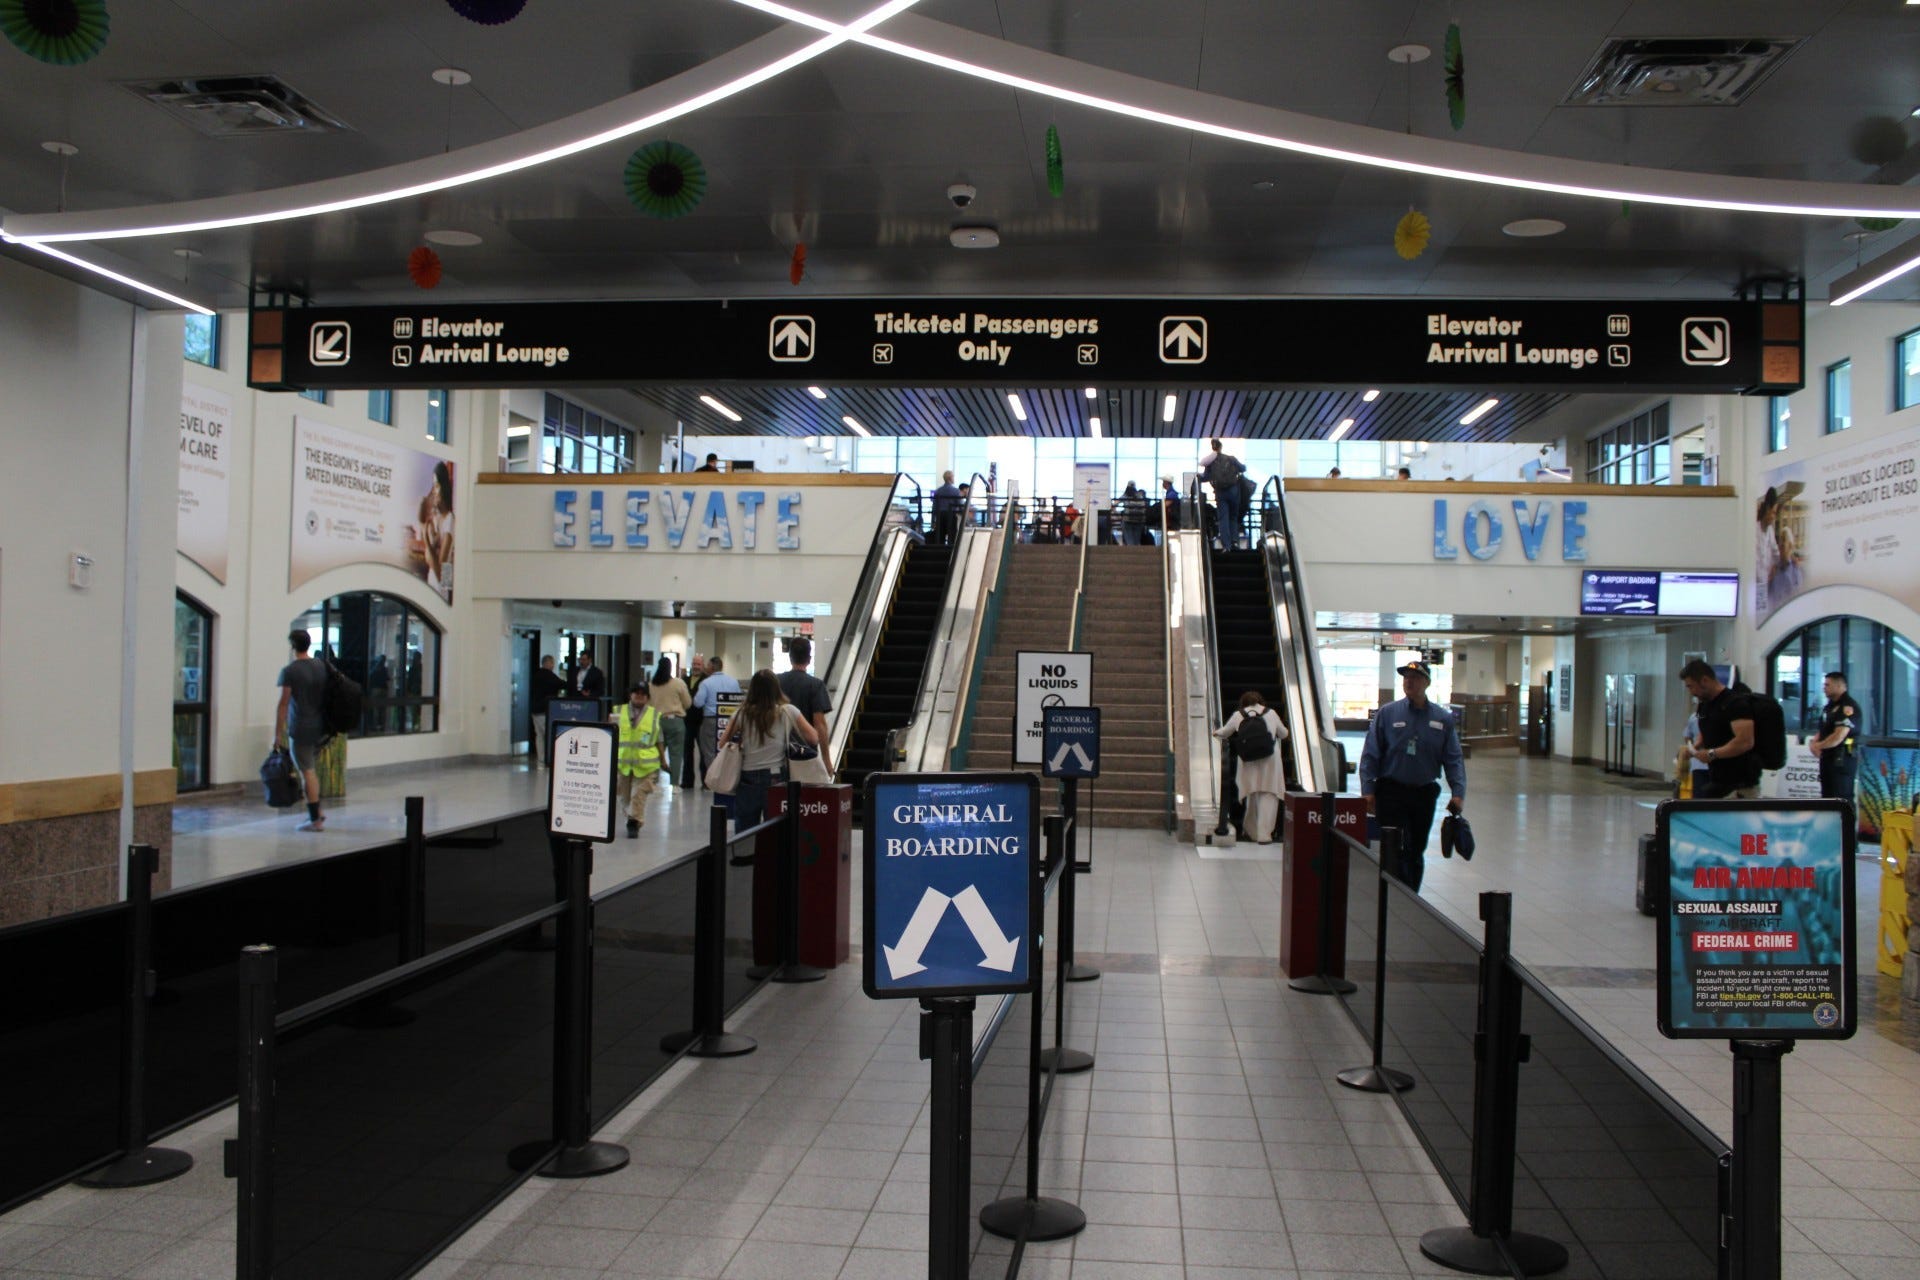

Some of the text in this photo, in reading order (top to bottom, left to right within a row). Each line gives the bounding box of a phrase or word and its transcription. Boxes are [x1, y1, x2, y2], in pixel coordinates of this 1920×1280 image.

[421, 317, 504, 338] Elevator
[874, 313, 1099, 339] Ticketed Passengers
[1427, 314, 1522, 335] Elevator
[420, 342, 569, 367] Arrival Lounge
[958, 340, 1011, 366] Only
[1426, 341, 1599, 369] Arrival Lounge
[208, 420, 222, 438] OF
[188, 439, 218, 461] CARE
[305, 446, 321, 464] THE
[322, 451, 359, 473] REGION'S
[361, 460, 392, 480] HIGHEST
[305, 466, 331, 484] RATED
[332, 472, 371, 494] MATERNAL
[372, 481, 391, 498] CARE
[1825, 458, 1915, 495] SIX CLINICS LOCATED
[1821, 478, 1918, 513] THROUGHOUT EL PASO
[553, 490, 801, 549] ELEVATE
[1434, 498, 1588, 561] LOVE
[1601, 575, 1628, 584] AIRPORT
[1628, 576, 1657, 584] BADGING
[1041, 664, 1066, 677] NO
[1029, 679, 1078, 689] LIQUIDS
[1052, 715, 1092, 723] GENERAL
[1026, 730, 1043, 738] THI
[1050, 726, 1094, 734] BOARDING
[781, 800, 828, 817] Rcycle
[893, 804, 1013, 824] GENERAL
[886, 836, 1020, 857] BOARDING
[1741, 834, 1768, 855] BE
[1693, 867, 1816, 889] AIR AWARE
[1678, 903, 1778, 913] SEXUAL ASSAULT
[1718, 918, 1782, 928] AIRCRAFT
[1697, 935, 1793, 948] FEDERAL CRIME
[1753, 985, 1772, 993] flight
[1762, 977, 1790, 985] aircraft,
[1719, 993, 1761, 1001] tips.fbi.gov
